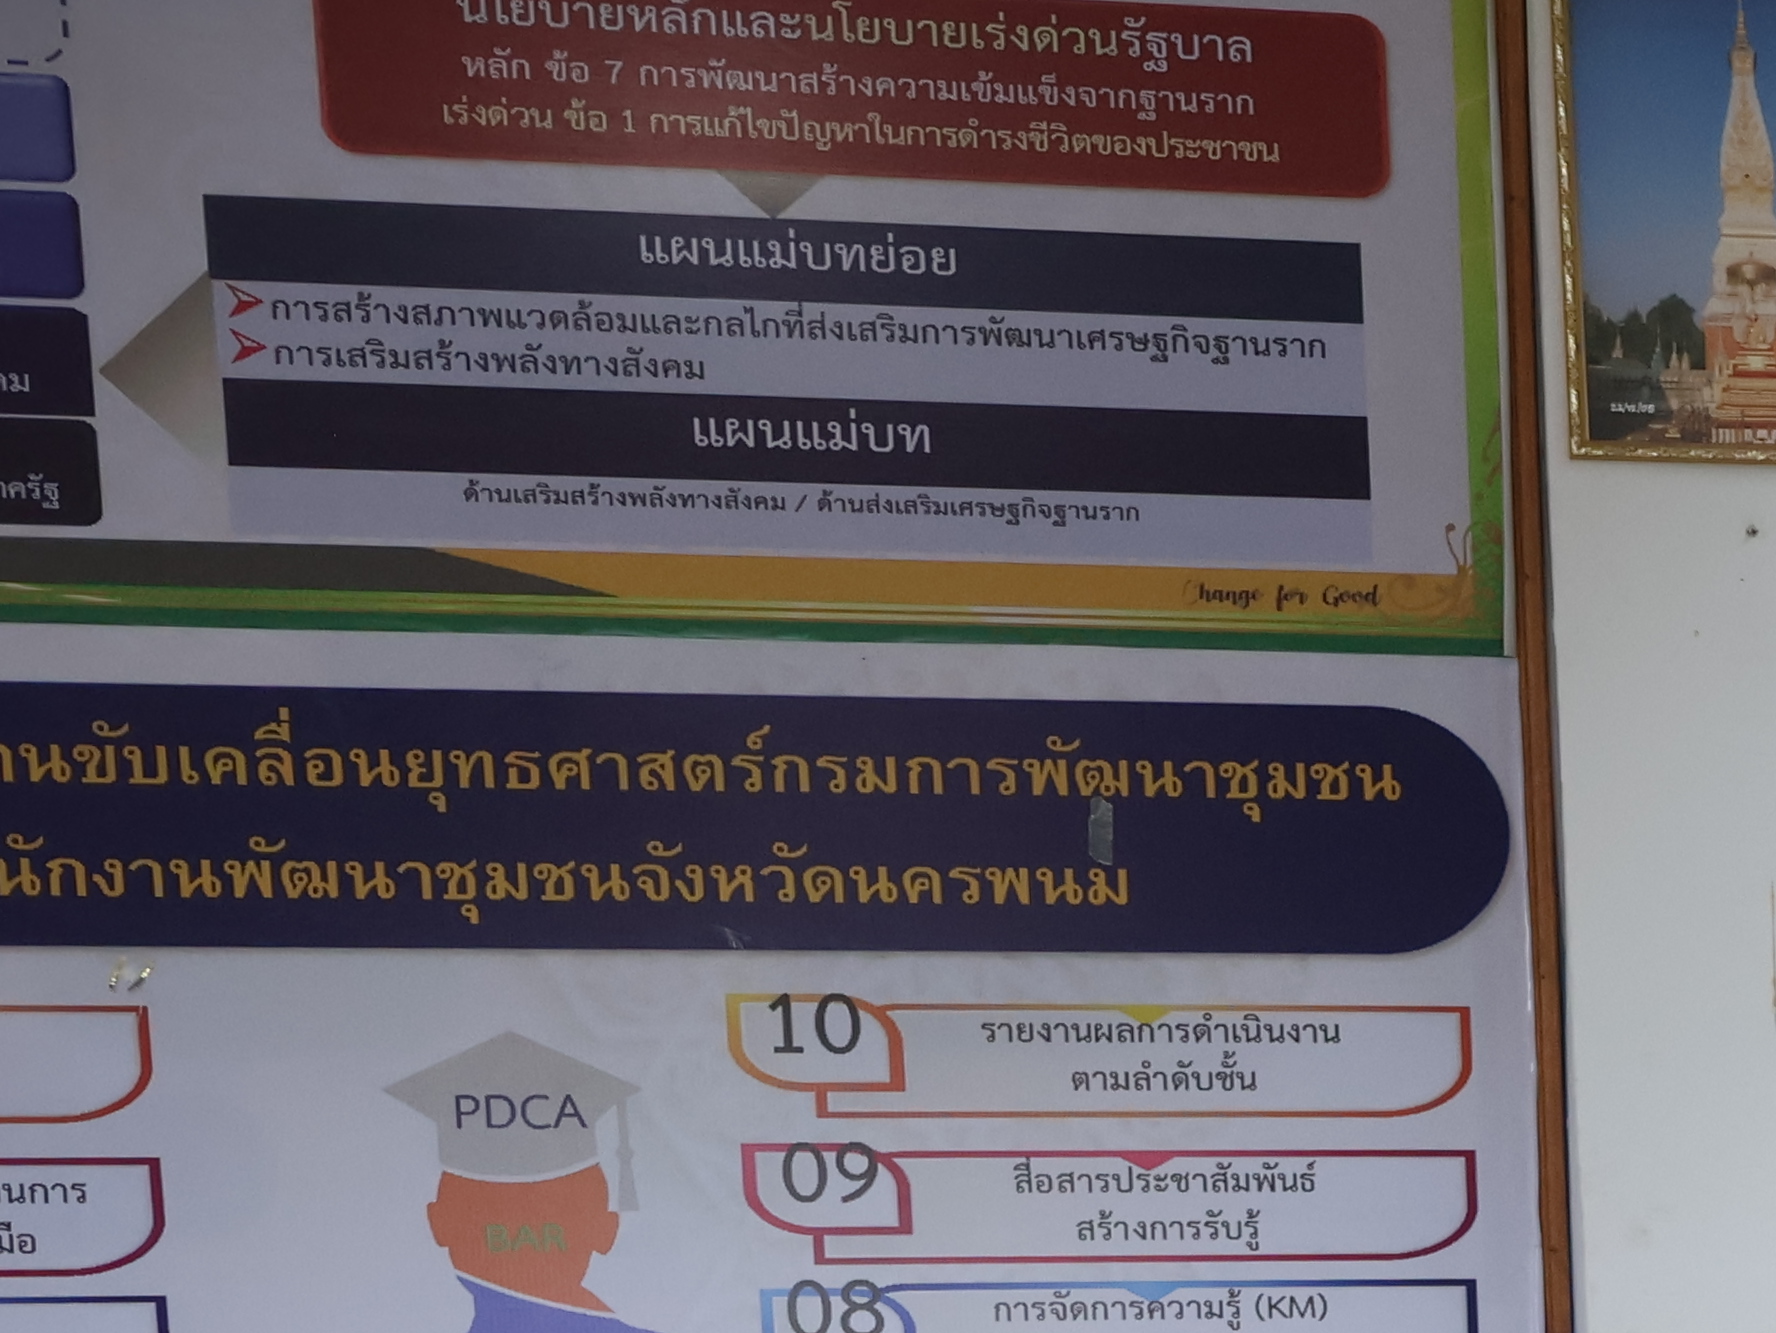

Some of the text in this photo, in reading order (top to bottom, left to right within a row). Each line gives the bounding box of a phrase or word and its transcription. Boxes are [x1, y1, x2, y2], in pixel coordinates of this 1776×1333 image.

[461, 49, 1254, 119] หลัก ข้อ 7 การพัฒนาสร้างความเข้มแข็งจากฐานราก
[442, 99, 1280, 164] เร่งด่วน ข้อ 1 การแก้ไขปัญหาในการดำรงชีวิตของประชาชน
[639, 228, 957, 276] แผนแม่บทย่อย
[270, 292, 1326, 363] การสร้างสภาพแวดล้อมและกลไกที่ส่งเสริมการพัฒนาเศรษฐกิจฐานราก
[274, 337, 705, 381] การเสริมสร้างพลังทางสังคม
[692, 409, 931, 454] แผนแม่บท
[463, 481, 786, 513] ด้านเสริมสร้างพลังทางสังคม
[817, 490, 1140, 526] ด้านส่งเสริมเศรษฐกิจฐานราก
[1322, 583, 1381, 608] Good
[770, 994, 861, 1054] 10
[981, 1018, 1341, 1046] รายงานผลการดำเนินงาน
[1071, 1052, 1257, 1093] ตามลำดับชั้น
[454, 1095, 589, 1129] PDCA
[783, 1142, 879, 1203] 09
[1014, 1160, 1316, 1195] สื่อสารประชาสัมพันธ์
[484, 1223, 568, 1253] BAR
[1076, 1210, 1260, 1251] สร้างการรับรู้
[994, 1291, 1328, 1331] การจัดการความรู้ (KM)
